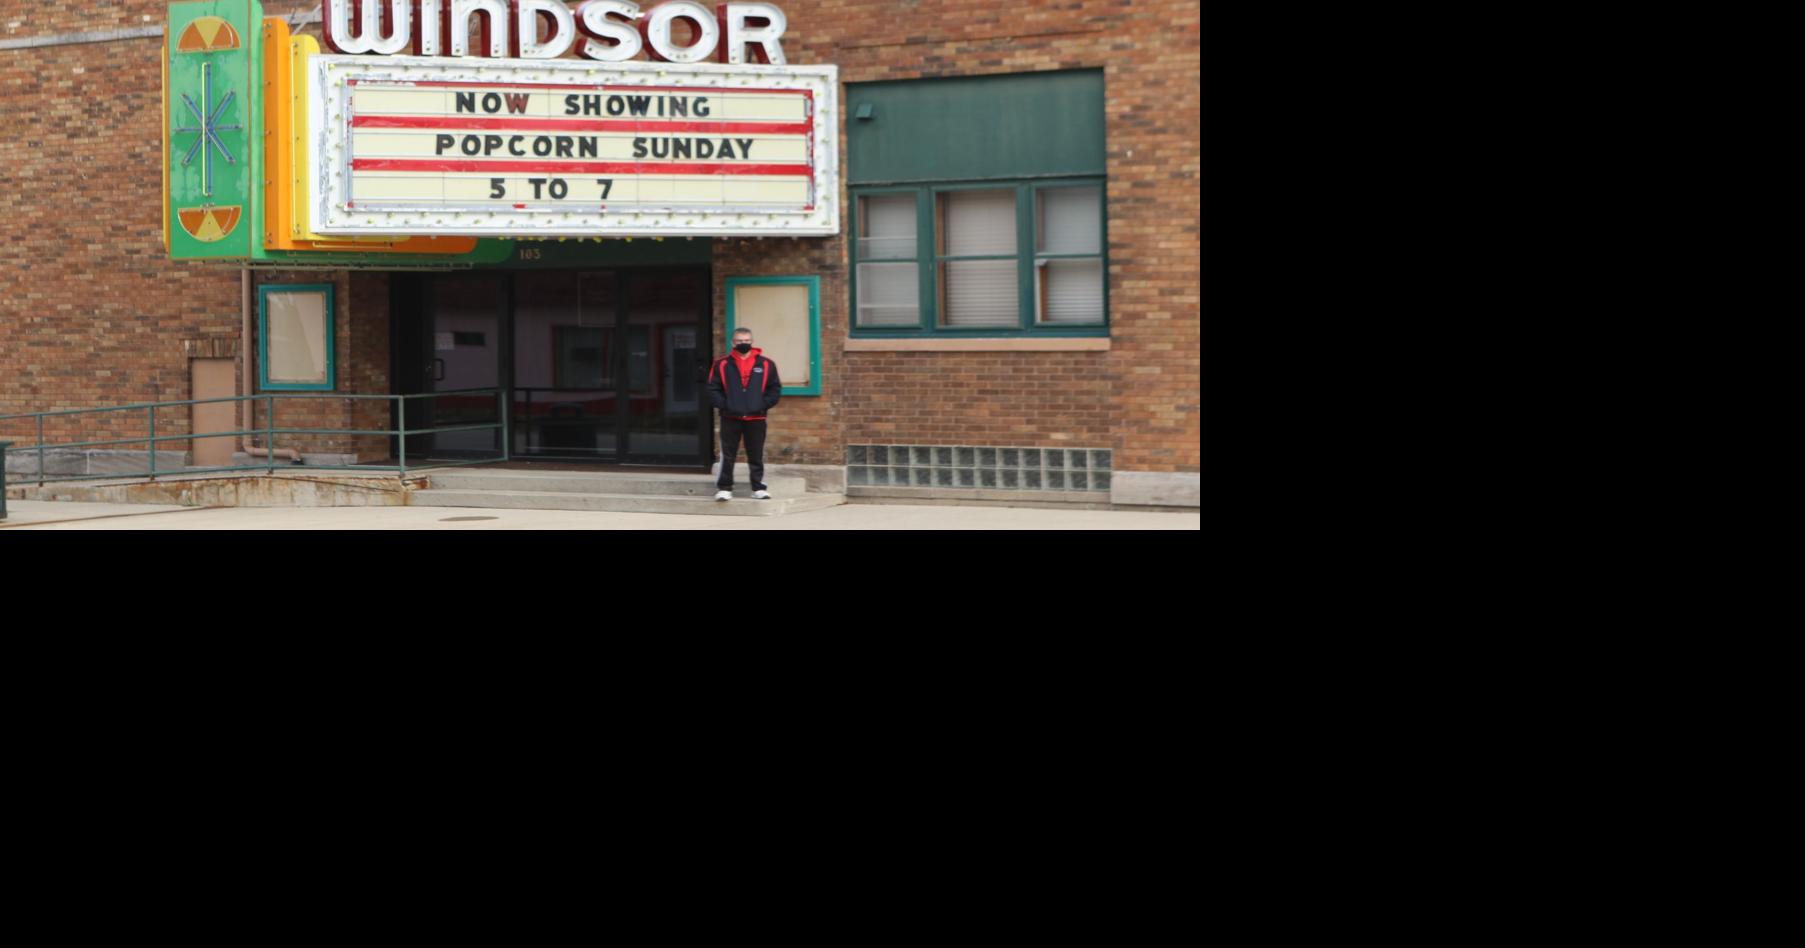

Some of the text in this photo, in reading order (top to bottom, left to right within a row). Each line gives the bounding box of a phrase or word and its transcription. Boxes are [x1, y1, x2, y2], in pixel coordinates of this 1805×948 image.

[455, 91, 711, 118] NOW SHOWING
[435, 133, 755, 160] POPCORN SUNDAY
[489, 177, 613, 200] 5 TO 7
